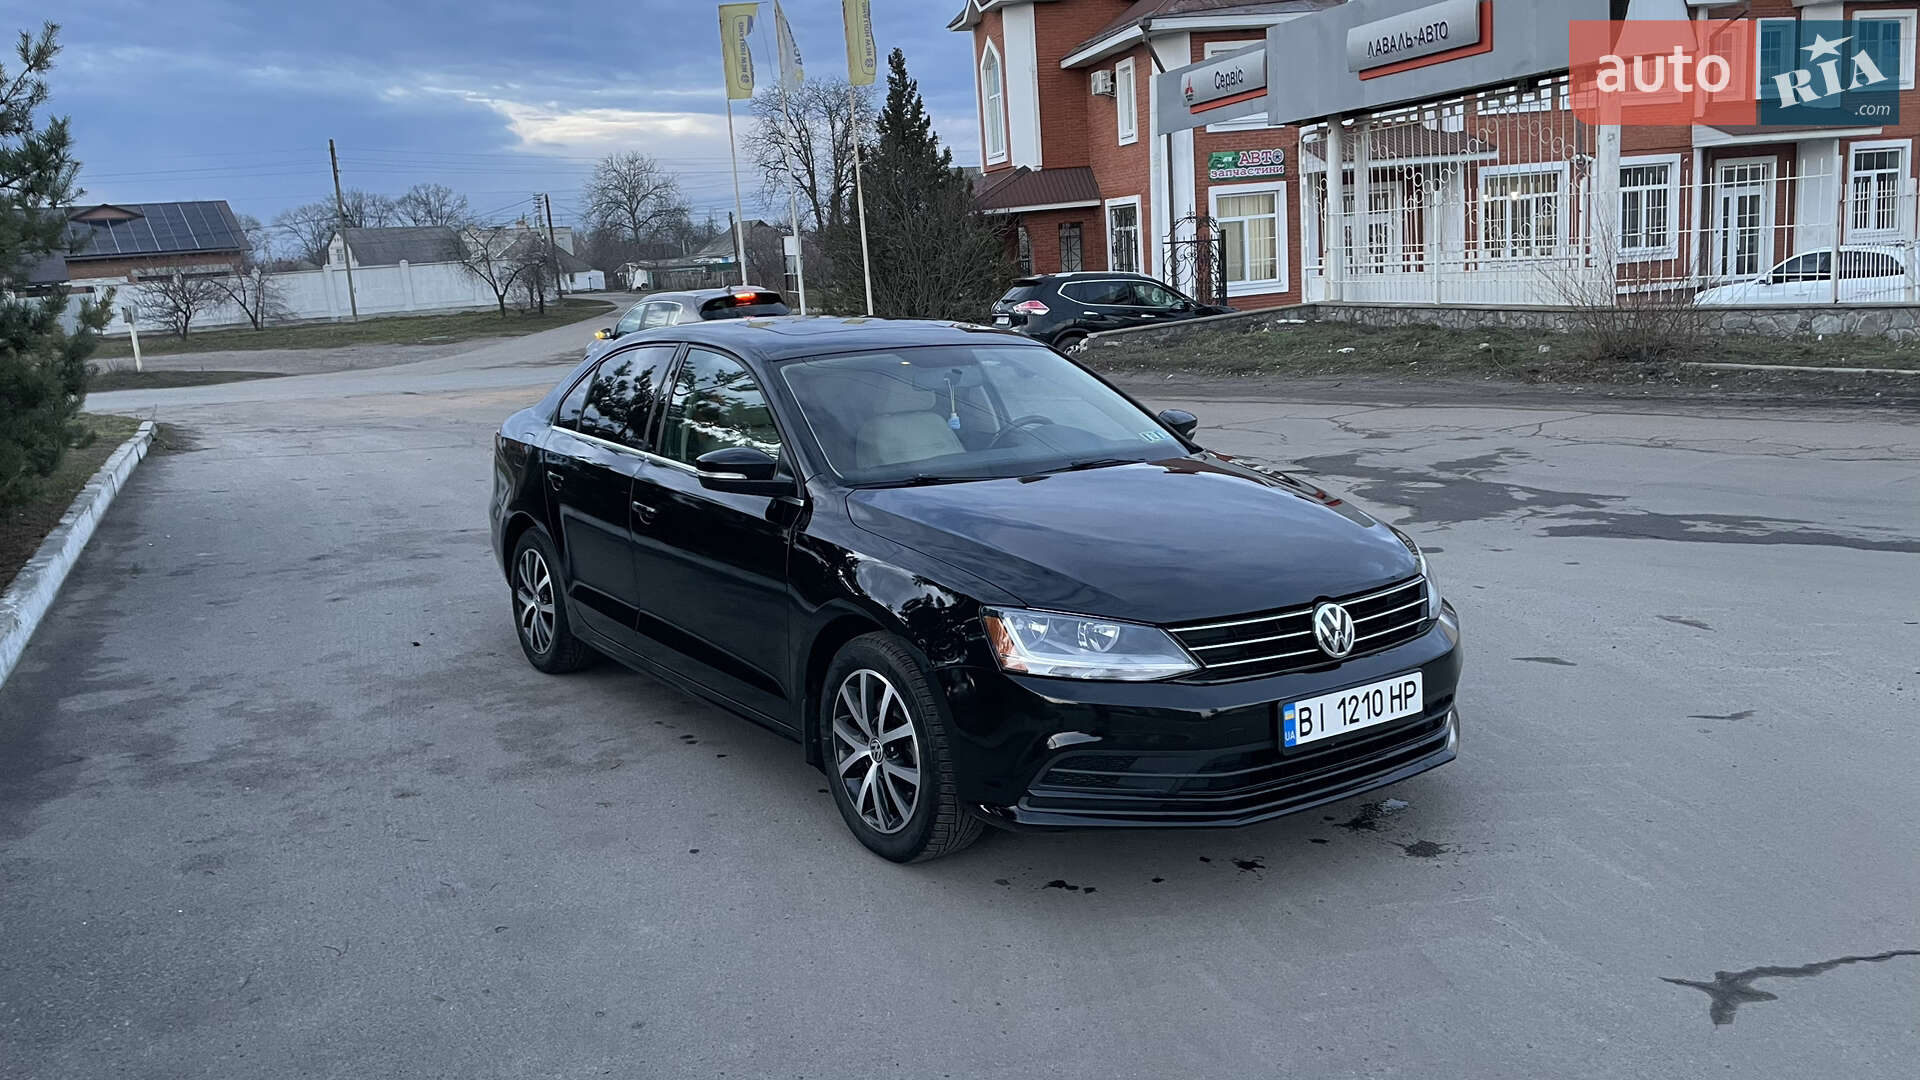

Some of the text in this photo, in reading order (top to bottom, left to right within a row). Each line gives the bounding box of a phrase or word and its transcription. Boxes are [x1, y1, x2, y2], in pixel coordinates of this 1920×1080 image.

[1367, 21, 1449, 58] ЛАВАЛЬ-АВТО
[1214, 65, 1244, 90] Сервіс
[1238, 149, 1284, 166] АВТО
[1298, 680, 1417, 738] BI 1210 HP
[1285, 731, 1295, 741] UA
